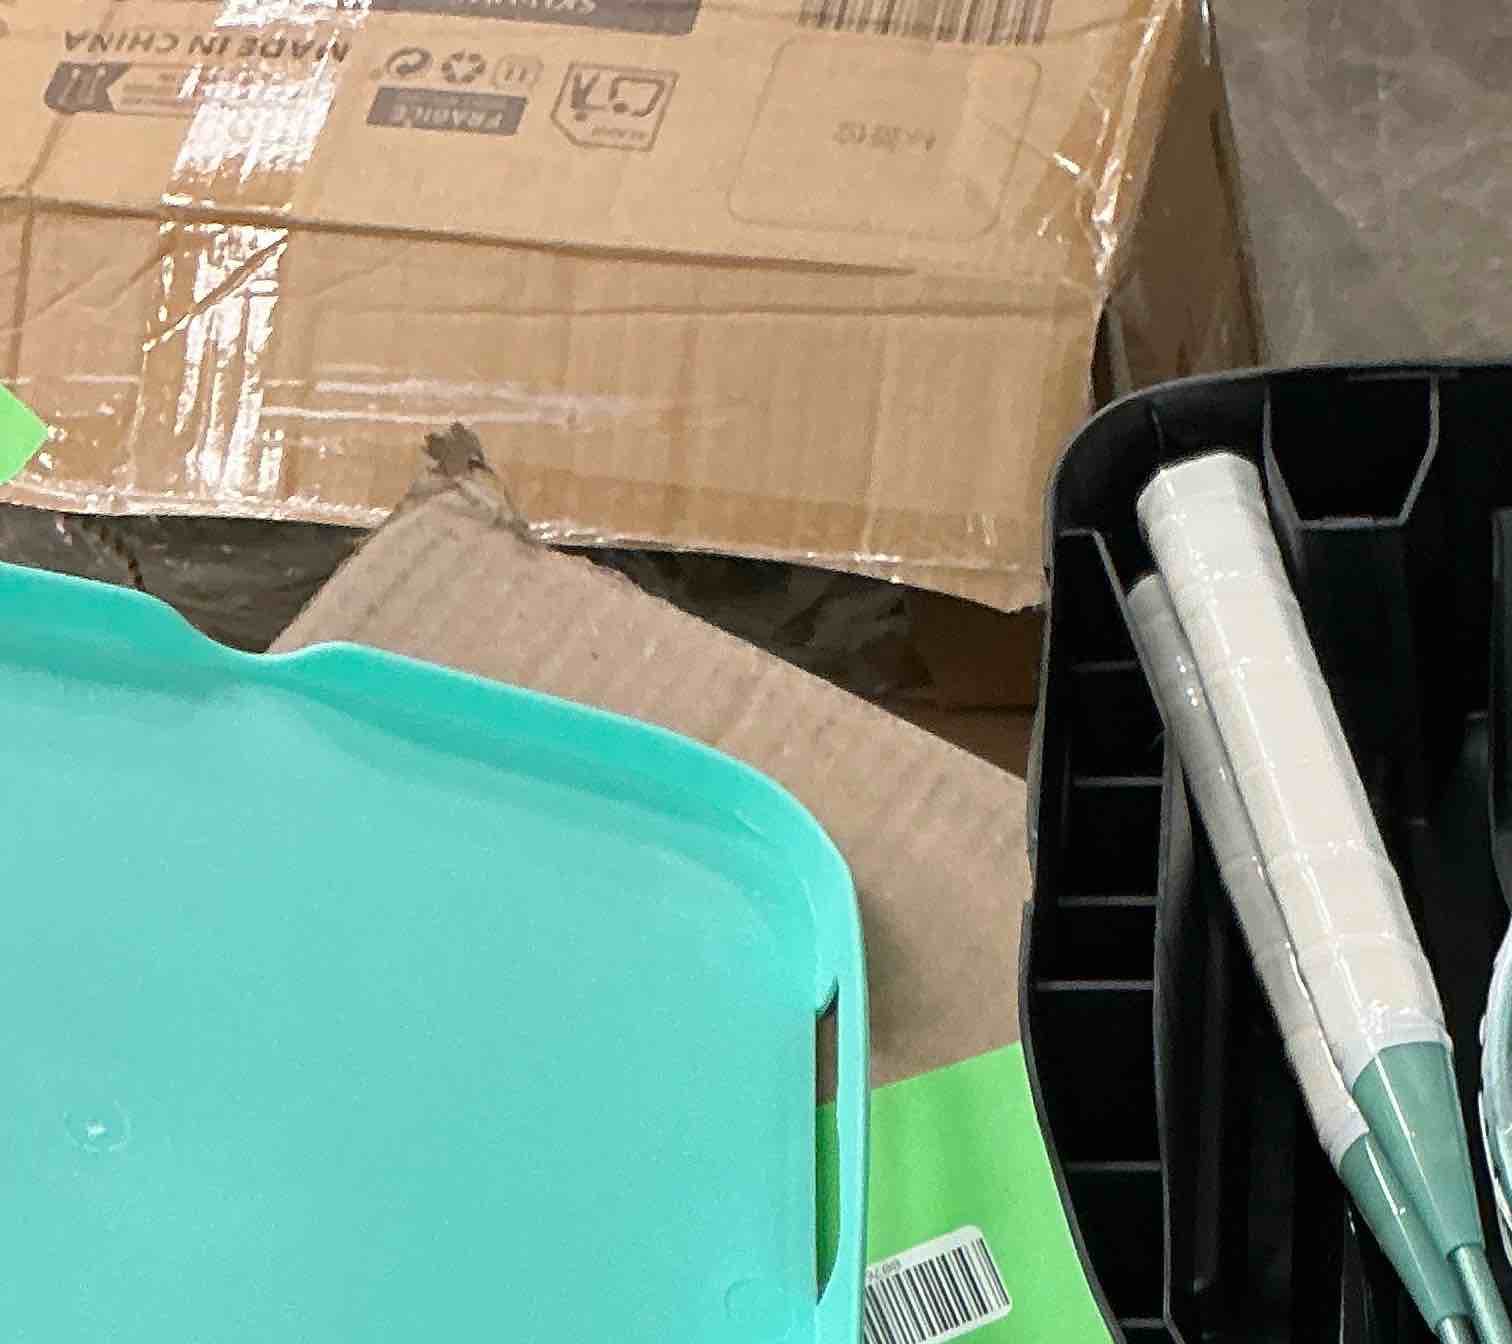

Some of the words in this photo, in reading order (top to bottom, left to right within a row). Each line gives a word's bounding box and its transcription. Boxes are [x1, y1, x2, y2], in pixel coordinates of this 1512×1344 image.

[65, 29, 179, 52] CHINA
[189, 31, 228, 57] IN
[236, 29, 349, 62] MADE
